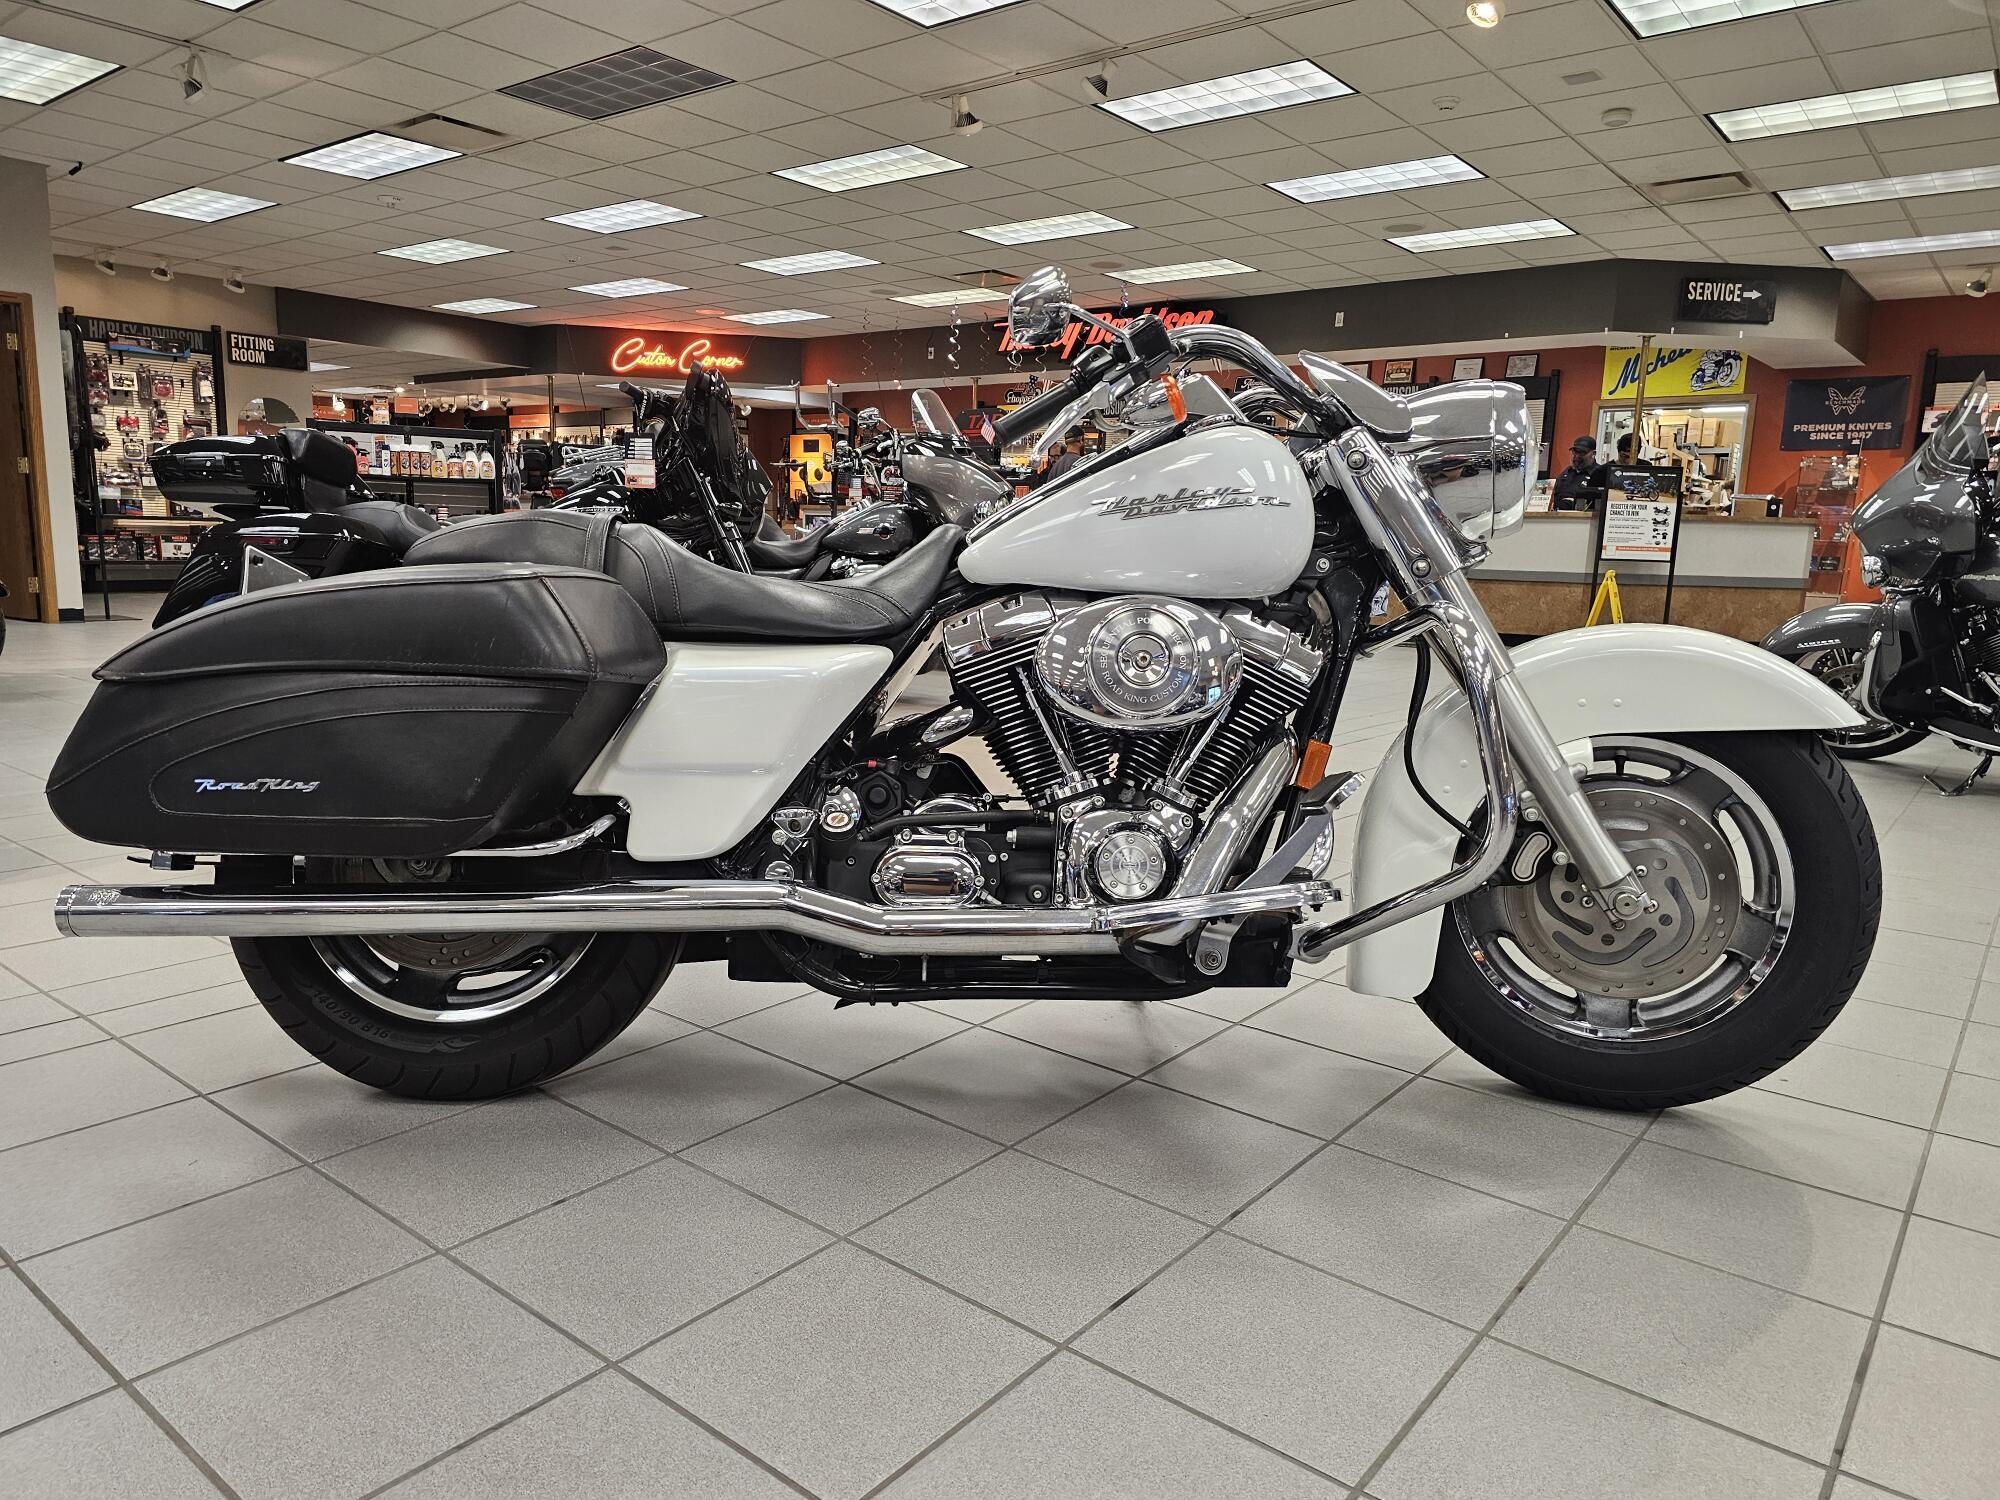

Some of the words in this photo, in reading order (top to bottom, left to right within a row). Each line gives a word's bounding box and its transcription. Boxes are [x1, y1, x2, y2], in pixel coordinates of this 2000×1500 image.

[1687, 281, 1742, 302] SERVICE
[230, 333, 275, 351] FITTING
[231, 348, 265, 364] ROOM
[612, 337, 677, 372] Custom
[679, 339, 744, 373] Corner
[1793, 423, 1845, 432] PREMIUM
[1848, 422, 1892, 431] KNIVES
[1809, 432, 1844, 440] SINCE
[1847, 431, 1873, 440] 1987
[1609, 509, 1625, 517] CHANCE
[1102, 671, 1123, 696] ROAD
[1124, 692, 1148, 704] KING
[194, 779, 259, 793] Road
[257, 778, 320, 793] King
